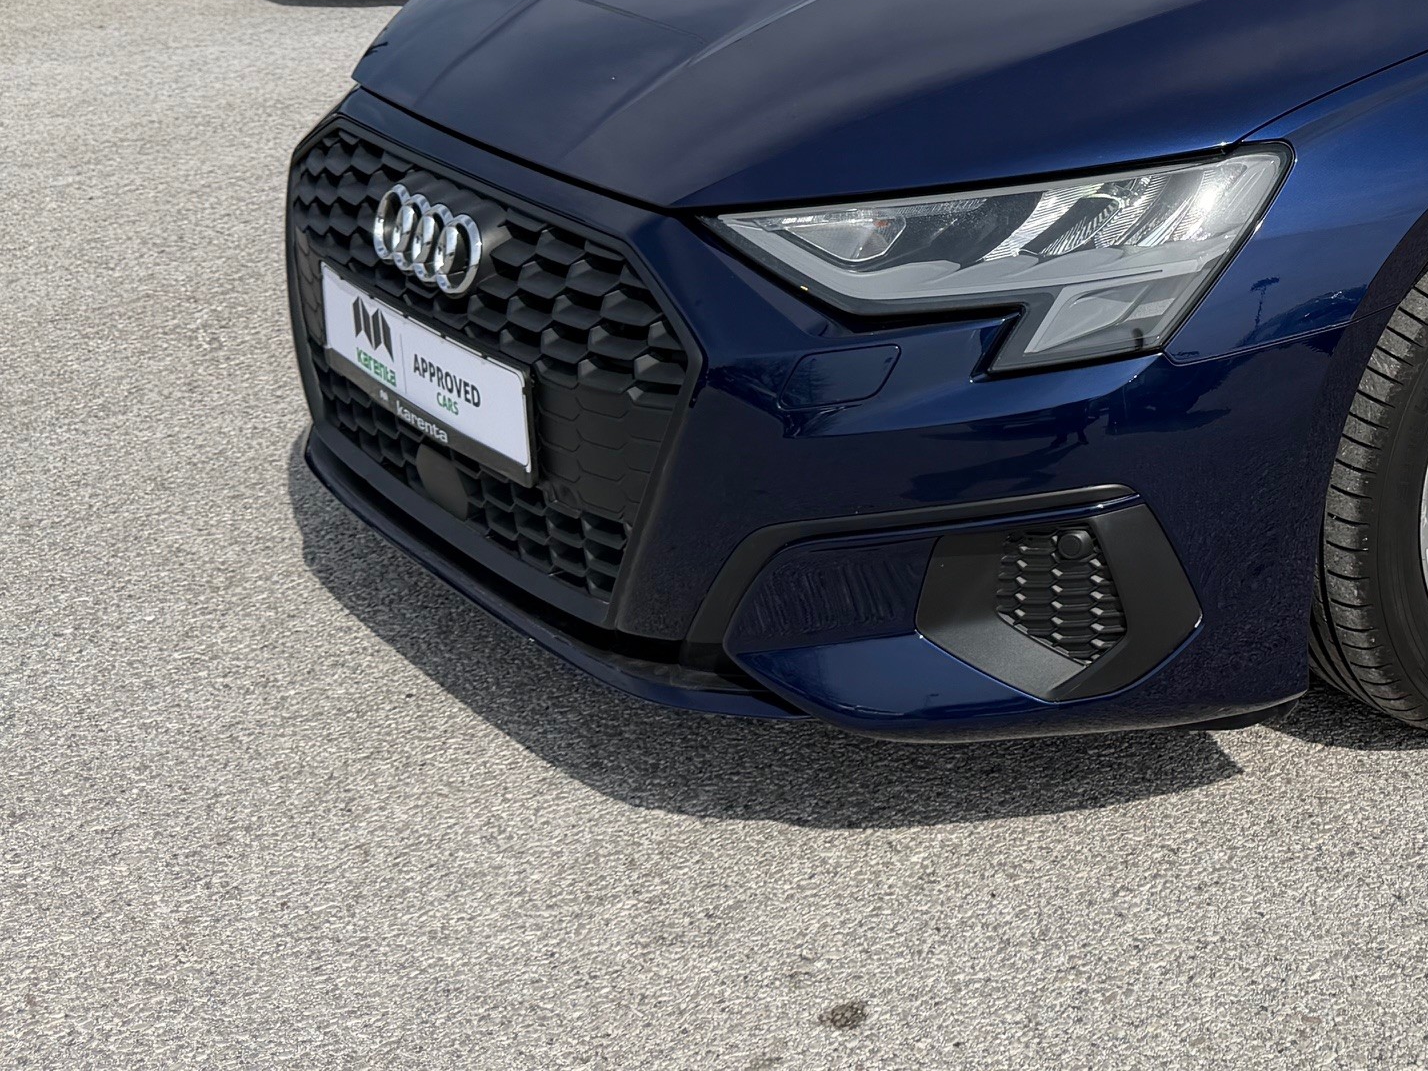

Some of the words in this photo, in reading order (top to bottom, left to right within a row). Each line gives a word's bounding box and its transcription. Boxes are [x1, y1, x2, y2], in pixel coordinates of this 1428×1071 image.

[356, 347, 397, 387] karenta
[413, 353, 481, 408] APPROVED
[396, 400, 448, 444] karenta
[436, 392, 459, 416] CARS
